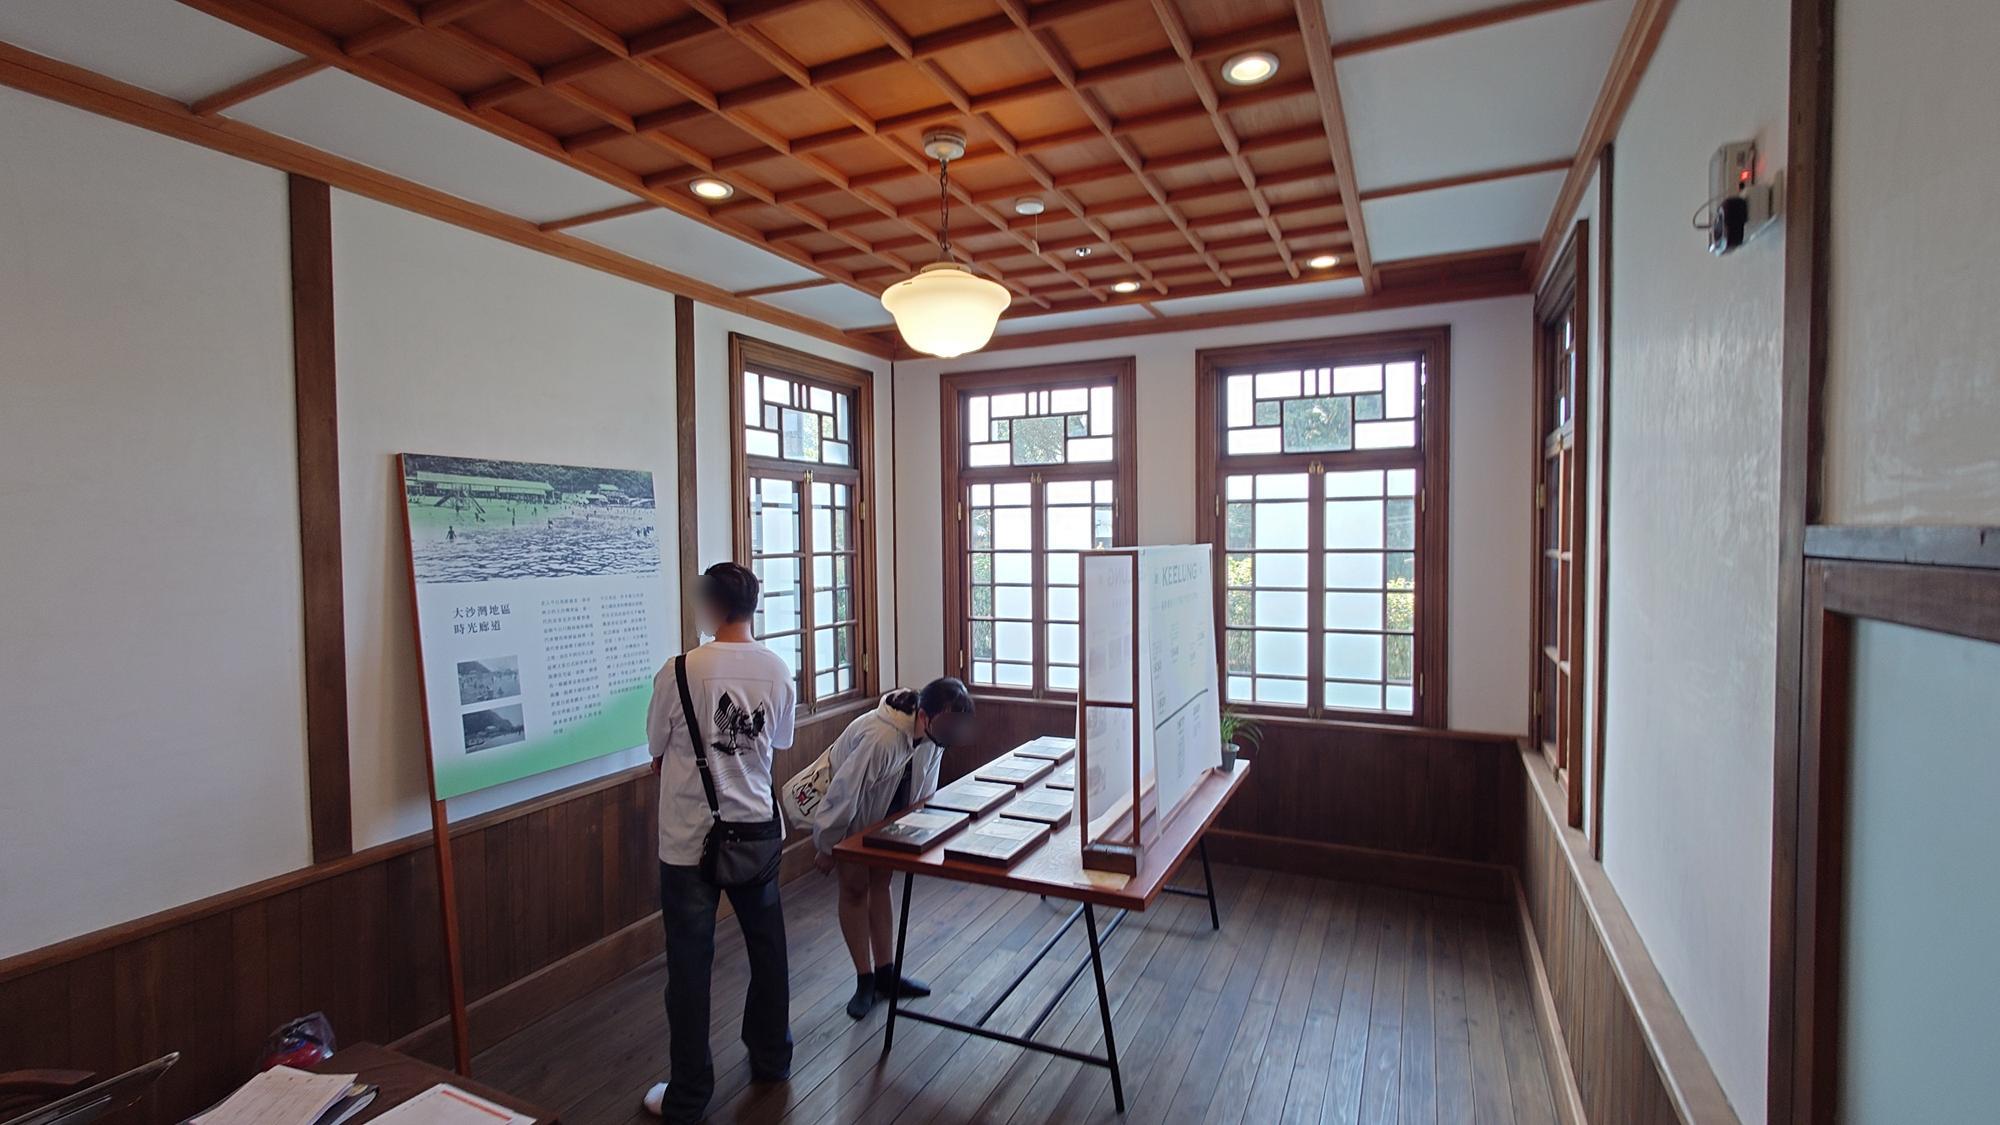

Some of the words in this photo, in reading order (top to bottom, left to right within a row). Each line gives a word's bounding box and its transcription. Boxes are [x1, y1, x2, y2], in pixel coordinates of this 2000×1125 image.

[1161, 563, 1198, 587] KEELUNG
[453, 603, 511, 618] 大沙灣地區
